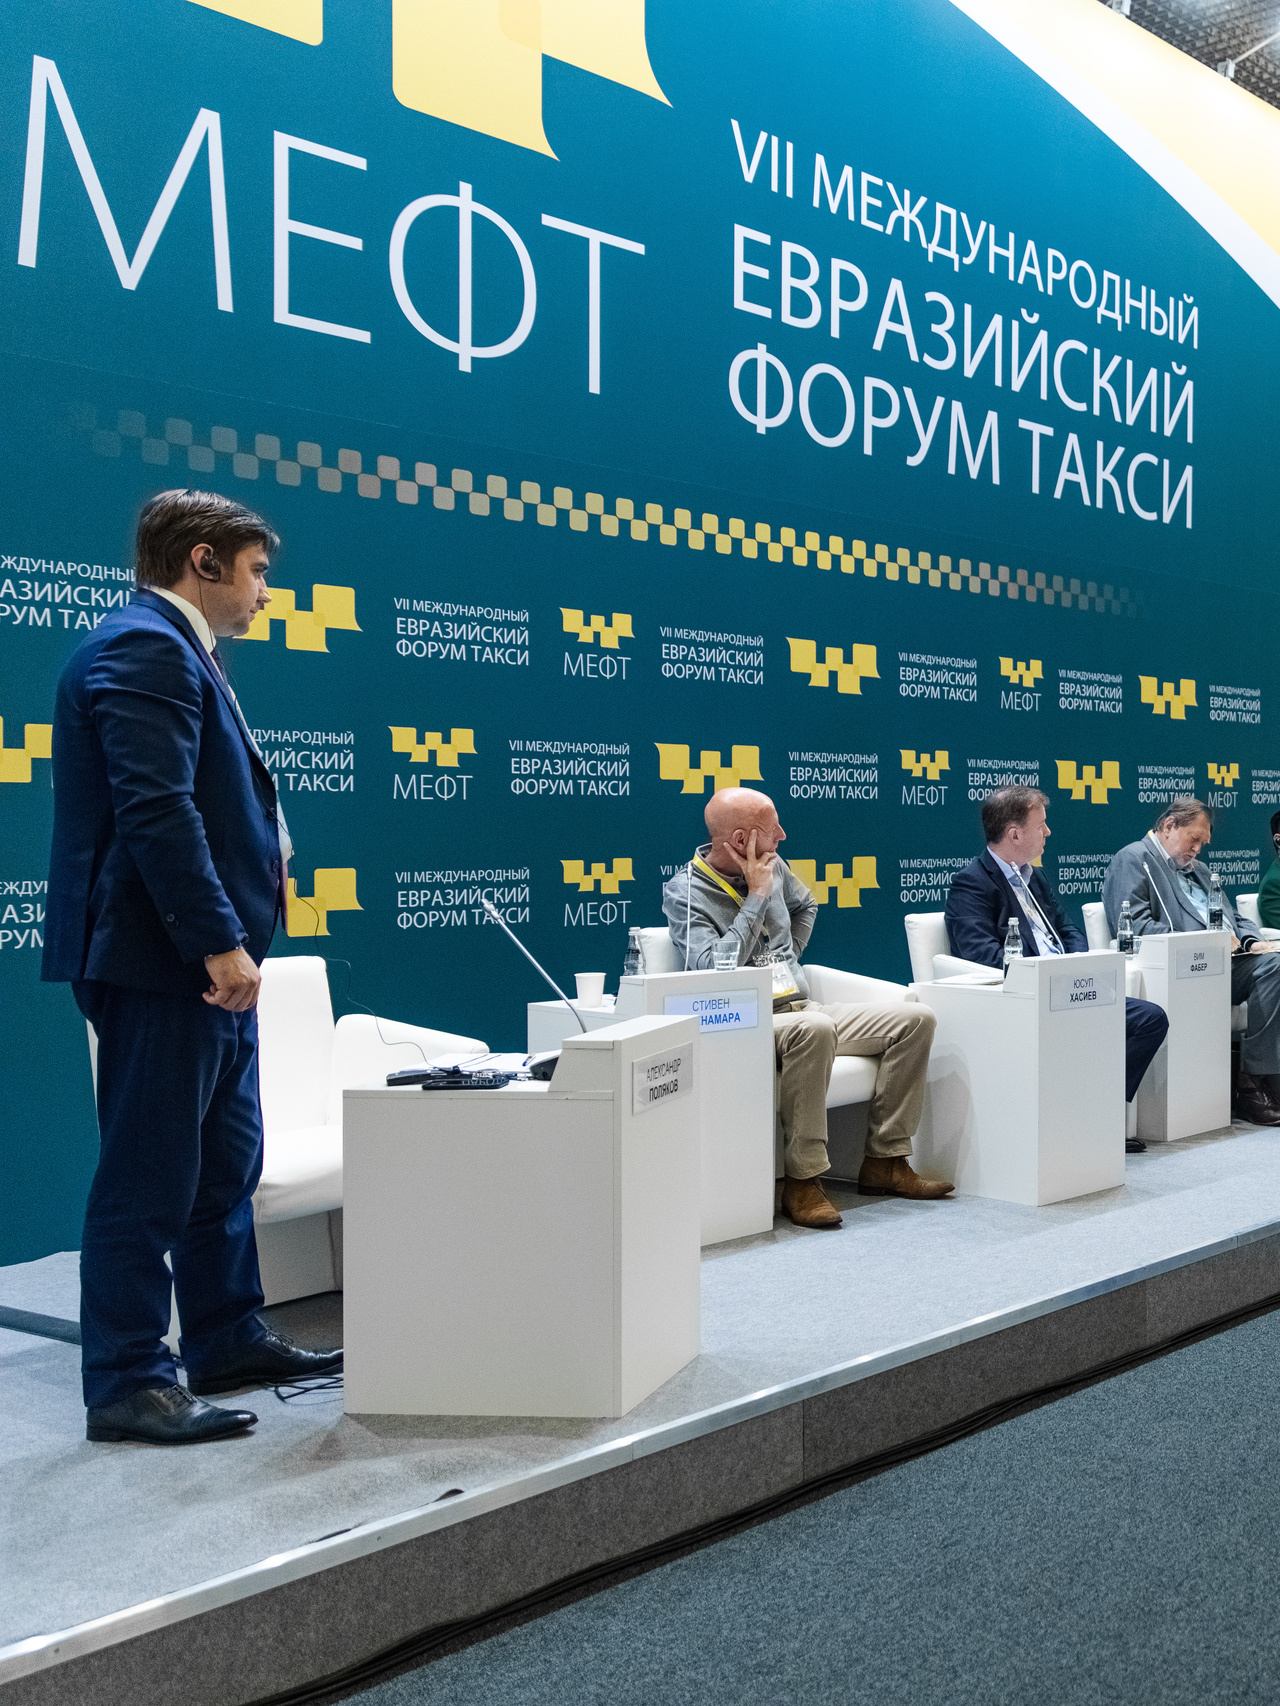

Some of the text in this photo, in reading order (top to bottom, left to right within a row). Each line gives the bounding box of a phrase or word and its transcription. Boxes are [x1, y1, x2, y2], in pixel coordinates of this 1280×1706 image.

[18, 54, 645, 394] МЕФТ
[730, 118, 1199, 349] VII МЕЖДУНАРОДНЫЙ
[734, 223, 1194, 443] ЕВРАЗИЙСКИЙ
[729, 342, 1192, 529] ФОРУМ ТАКСИ
[394, 597, 529, 623] VII МЕЖДУНАРОДНЫЙ
[397, 617, 529, 646] ЕВРАЗИЙСКИЙ
[660, 626, 763, 647] VII МЕЖДУНАРОДНЫЙ
[396, 638, 529, 666] ФОРУМ ТАКСИ
[662, 643, 763, 667] ЕВРАЗИЙСКИЙ
[898, 652, 977, 668] VII МЕЖДУНАРОДНЫЙ
[564, 652, 631, 680] МЕФТ
[661, 662, 763, 685] ФОРУМ ТАКСИ
[900, 667, 977, 686] ЕВРАЗИЙСКИЙ
[1058, 669, 1122, 683] VII МЕЖДУНАРОДНЫЙ
[899, 683, 977, 702] ФОРУМ ТАКСИ
[1059, 682, 1122, 699] ЕВРАЗИЙСКИЙ
[1216, 685, 1261, 697] МЕЖДУНАРОДНЫЙ
[1001, 690, 1042, 711] МЕФТ
[1059, 697, 1122, 713] ФОРУМ ТАКСИ
[1210, 696, 1260, 711] ЕВРАЗИЙСКИЙ
[1209, 709, 1260, 724] ФОРУМ ТАКСИ
[250, 729, 354, 746] ДУНАРОДНЫЙ
[509, 740, 630, 756] VII МЕЖДУНАРОДНЫЙ
[261, 747, 354, 770] ИЙСКИЙ
[788, 751, 878, 765] VII МЕЖДУНАРОДНЫЙ
[967, 759, 1039, 770] VII МЕЖДУНАРОДНЫЙ
[511, 757, 629, 776] ЕВРАЗИЙСКИЙ
[790, 766, 878, 783] ЕВРАЗИЙСКИЙ
[1145, 766, 1195, 775] МЕЖДУНАРОДНЫЙ
[284, 773, 354, 792] ТАКСИ
[511, 778, 629, 796] ФОРУМ ТАКСИ
[968, 772, 1039, 786] ЕВРАЗИЙСКИЙ
[1139, 777, 1195, 790] ЕВРАЗИЙСКИЙ
[393, 774, 473, 801] МЕФТ
[789, 784, 878, 799] ФОРУМ ТАКСИ
[902, 785, 948, 806] МЕФТ
[968, 788, 1002, 801] ФОРУ
[1138, 791, 1168, 803] ФОРУМ
[1208, 792, 1238, 808] МЕФТ
[1252, 793, 1277, 804] ФОРУМ
[1215, 848, 1260, 859] МЕЖДУНАРОДНЫЙ
[660, 865, 672, 875] VII
[899, 859, 909, 868] VII
[1209, 859, 1260, 873] ЕВРАЗИЙСКИЙ
[395, 867, 530, 884] VII МЕЖДУНАРОДНЫЙ
[1220, 873, 1259, 885] РУМ ТАКСИ
[398, 884, 529, 907] ЕВРАЗИЙСКИЙ
[900, 889, 941, 903] ФОРУМ
[1058, 882, 1092, 895] ФОРУМ
[397, 910, 467, 929] ФОРУМ
[564, 900, 632, 927] МЕФТ
[1190, 962, 1208, 972] ФАБЕР
[1073, 977, 1095, 990] ЮСУП
[692, 998, 730, 1012] СТИВЕН
[1069, 991, 1097, 1004] ХАСИЕВ
[700, 1012, 741, 1026] НАМАРА
[646, 1057, 682, 1082] АЛЕКСАНДР
[649, 1078, 679, 1102] ПОЛЯКОВ
